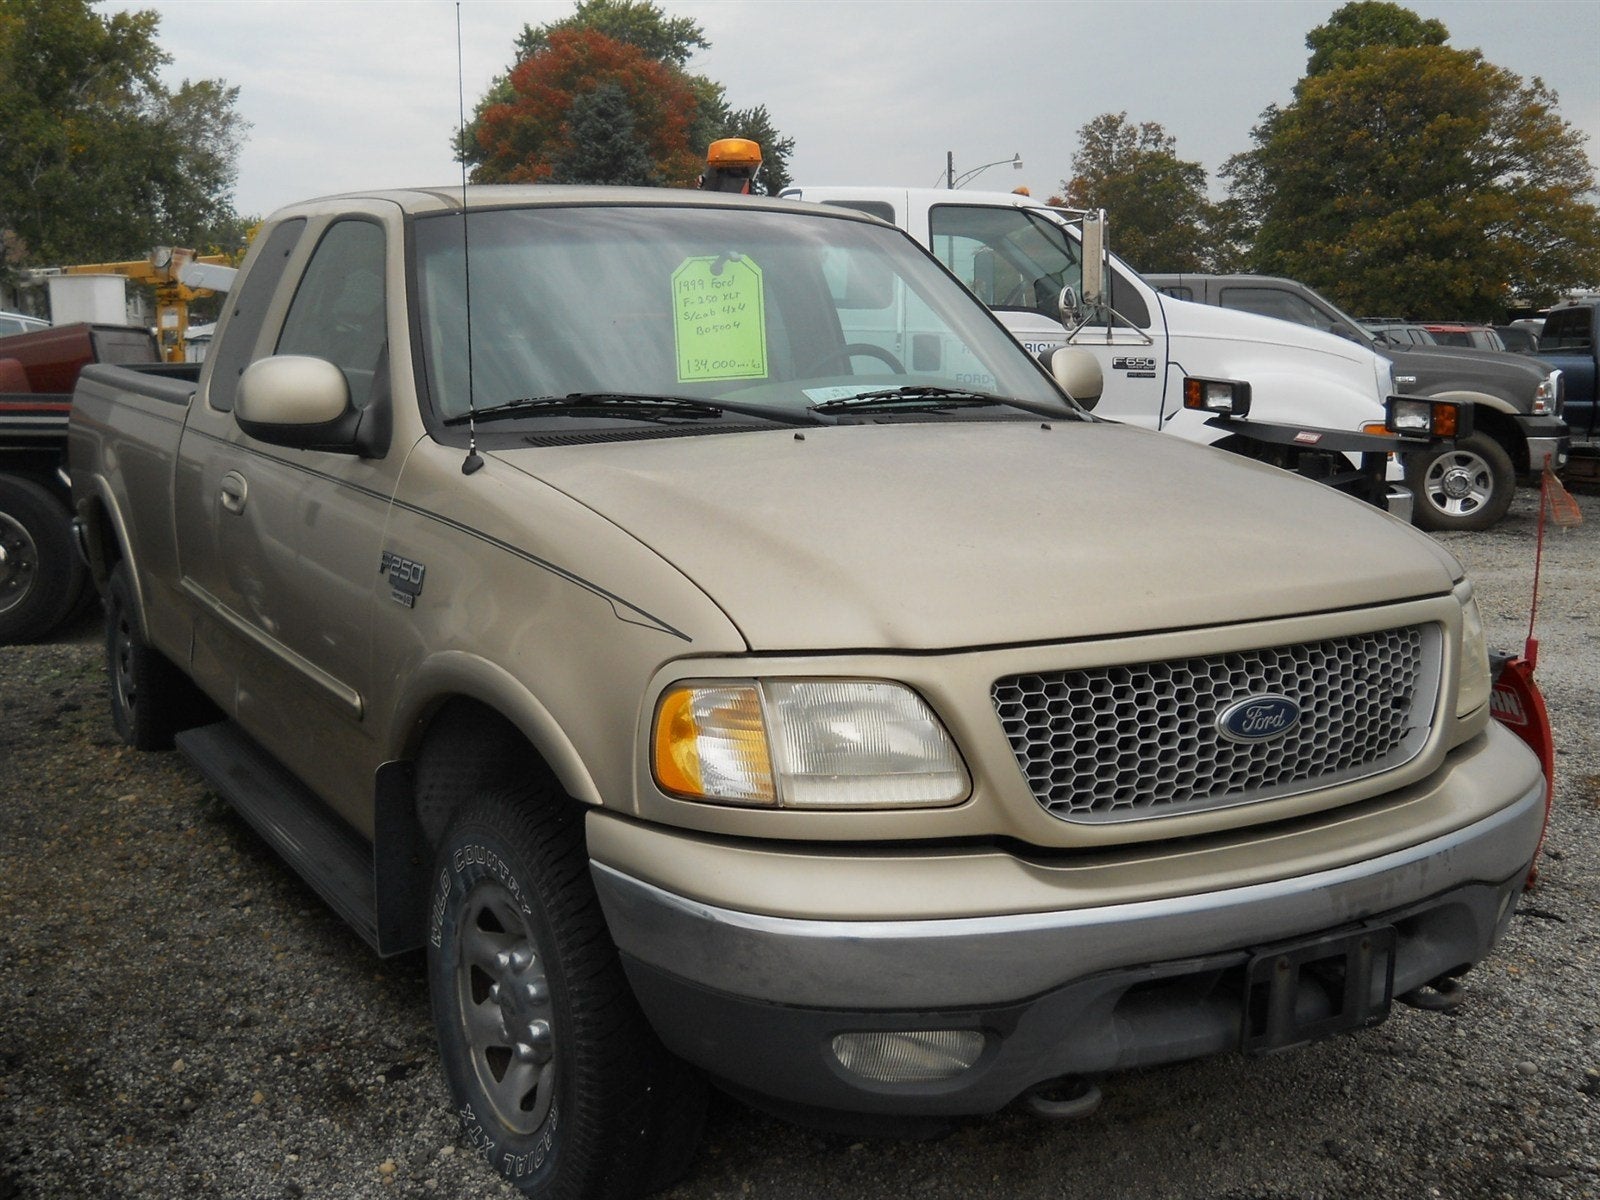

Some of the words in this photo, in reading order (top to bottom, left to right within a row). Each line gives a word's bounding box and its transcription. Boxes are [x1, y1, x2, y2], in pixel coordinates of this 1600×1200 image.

[679, 279, 704, 293] 1999
[711, 275, 735, 289] Ford
[683, 295, 717, 307] F-250
[723, 291, 741, 301] XLT
[722, 303, 745, 314] 4x4
[1242, 704, 1285, 733] Ford
[431, 867, 452, 949] WILD
[453, 843, 532, 915] COUNTRY
